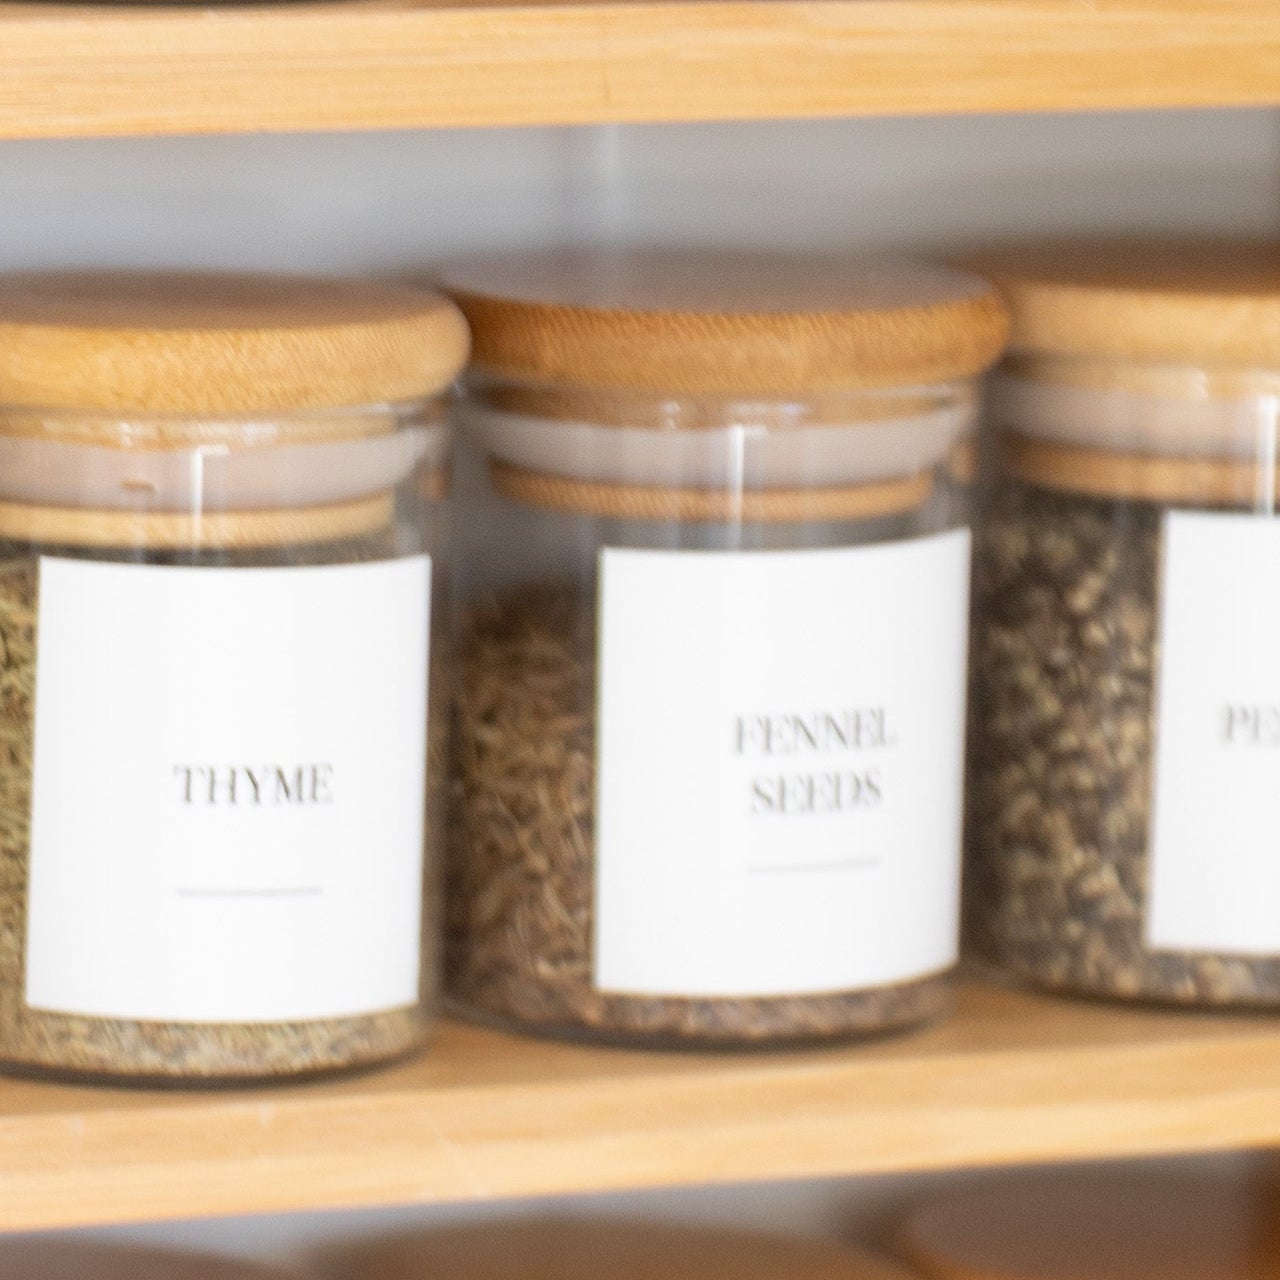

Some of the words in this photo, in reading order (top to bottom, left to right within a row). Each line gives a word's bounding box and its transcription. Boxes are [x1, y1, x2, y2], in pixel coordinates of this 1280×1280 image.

[735, 708, 895, 754] FENNEL
[175, 763, 332, 804] THYME
[751, 771, 882, 815] SEEDS
